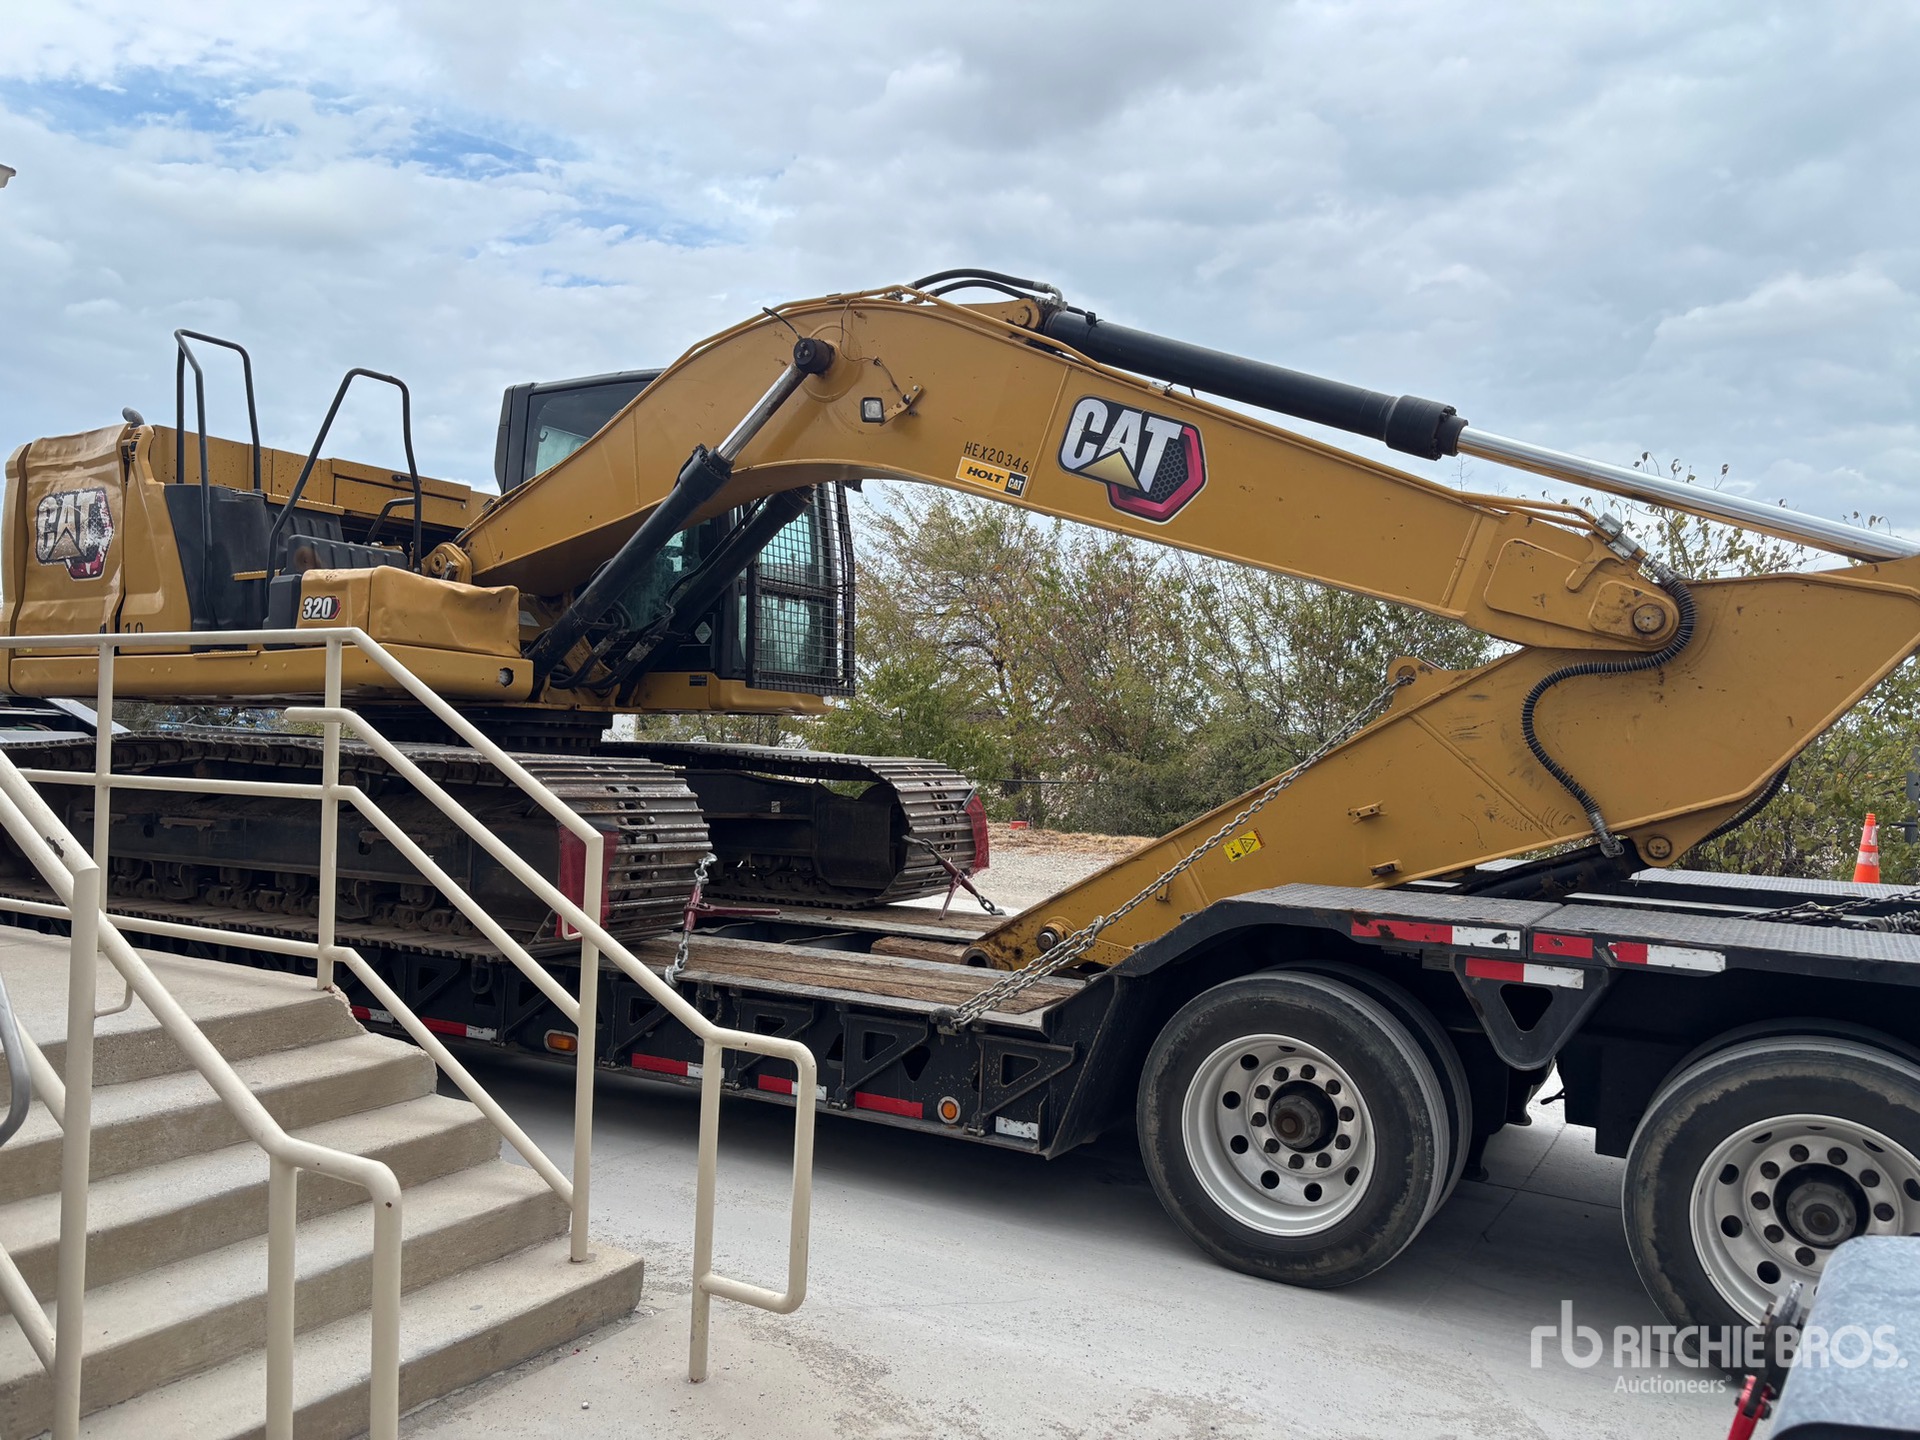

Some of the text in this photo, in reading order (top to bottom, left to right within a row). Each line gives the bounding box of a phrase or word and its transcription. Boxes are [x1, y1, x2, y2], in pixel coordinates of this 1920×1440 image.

[963, 441, 1029, 473] HEX20346
[1060, 397, 1183, 493] CAT
[966, 466, 1024, 491] HOLT CAT
[37, 491, 97, 561] CAT
[302, 596, 333, 619] 320
